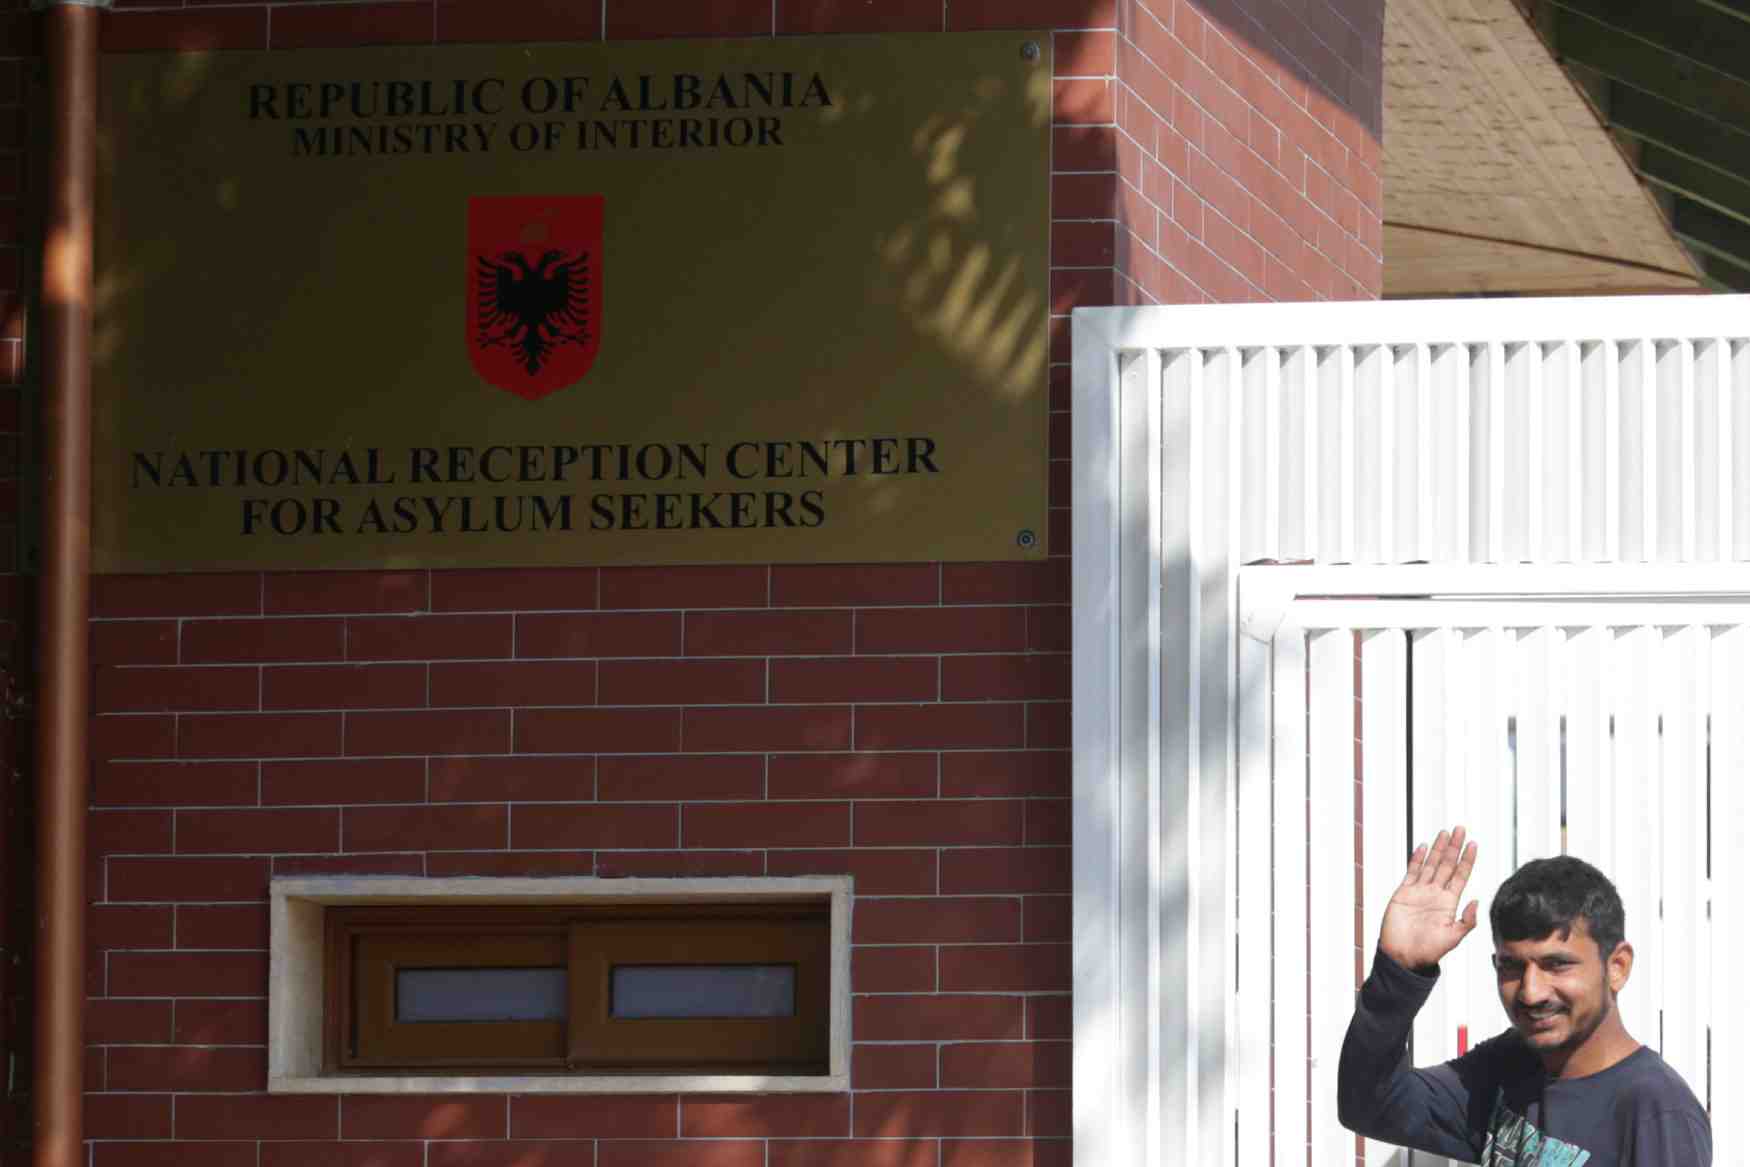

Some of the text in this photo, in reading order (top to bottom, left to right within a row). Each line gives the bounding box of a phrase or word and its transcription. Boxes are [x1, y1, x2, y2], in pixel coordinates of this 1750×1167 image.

[247, 71, 834, 121] REPUBLIC OF ALBANIA
[292, 116, 785, 157] MINISTRY OF INTERIOR
[130, 437, 940, 489] NATIONAL RECEPTION CENTER
[239, 490, 827, 536] FOR ASYLUM SEEKERS
